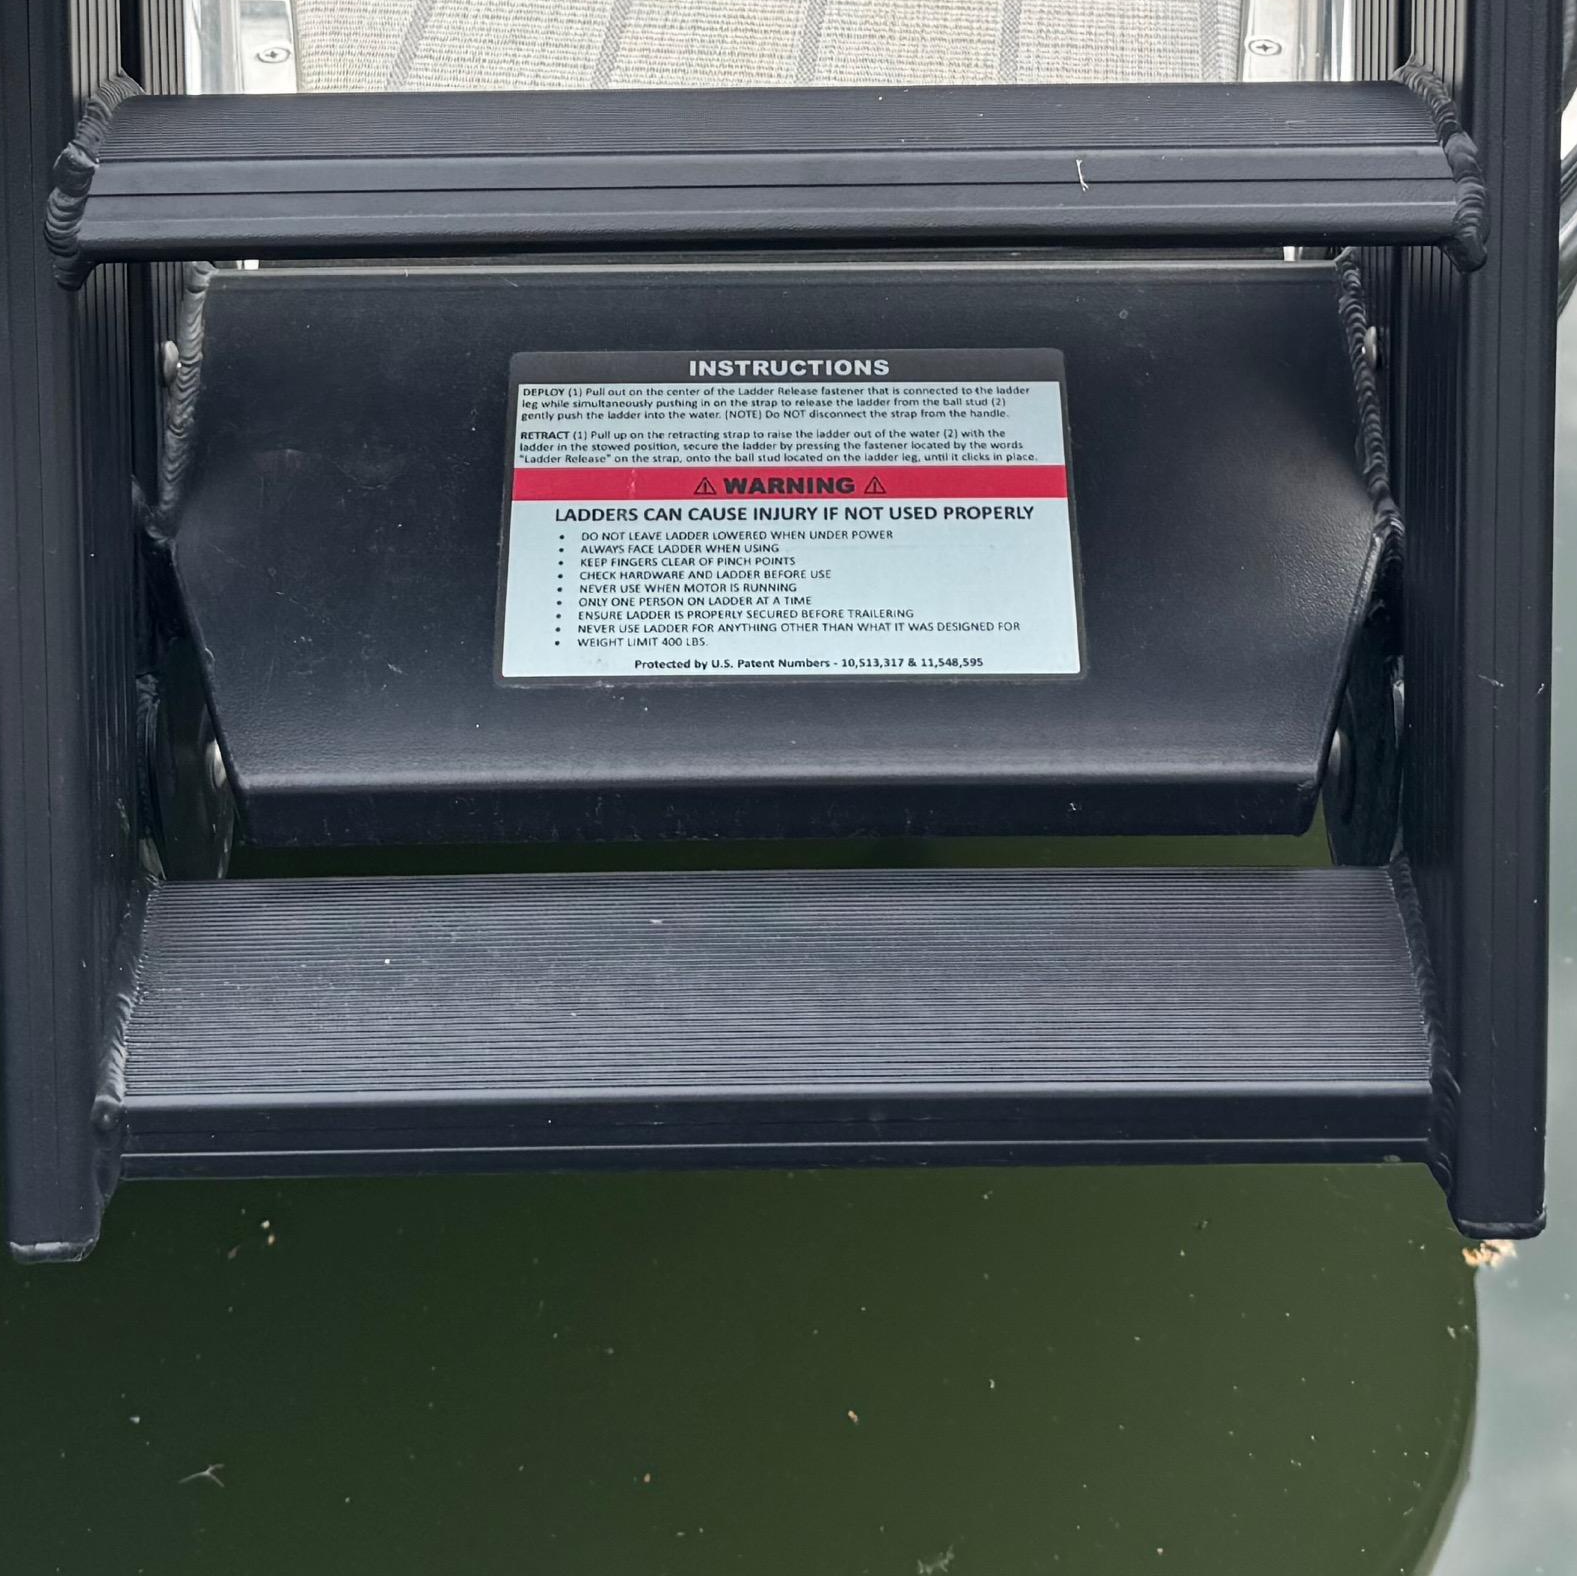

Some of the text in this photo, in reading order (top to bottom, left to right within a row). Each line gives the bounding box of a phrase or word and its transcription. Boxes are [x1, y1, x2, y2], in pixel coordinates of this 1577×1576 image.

[690, 359, 889, 377] INSTRUCTIONS
[523, 388, 565, 397] DEPLOY
[568, 387, 583, 398] (1)
[585, 387, 605, 396] Pull
[646, 387, 664, 396] the
[666, 388, 700, 396] center
[703, 387, 714, 396] of
[717, 387, 736, 396] the
[738, 387, 774, 396] Ladder
[777, 386, 818, 396] Release
[821, 386, 865, 396] fastener
[867, 386, 889, 396] that
[892, 387, 900, 395] is
[903, 386, 959, 395] connected
[961, 387, 973, 395] to
[974, 386, 993, 395] the
[996, 386, 1030, 395] ladder
[520, 428, 1006, 441] RETRACT (1) Pull up on the retracting strap to raise the ladder out of the water (2) with the
[723, 477, 855, 495] WARNING
[555, 506, 1034, 522] LADDERS CAN CAUSE INJURY IF NOT USED PROPERLY
[581, 530, 893, 541] DO NOT LEAVE LADDER LOWERED WHEN UNDER POWER
[580, 543, 780, 554] ALWAYS FACE LADDER WHEN USING
[580, 556, 796, 568] KEEP FINGERS CLEAR OF PINCH POINTS
[579, 569, 831, 581] CHECK HARDWARE AND LADDER BEFORE USE
[579, 582, 797, 594] NEVER USE WHEN MOTOR IS RUNNING
[578, 596, 811, 607] ONLY ONE PERSON ON LADDER AT A TIME
[578, 609, 914, 621] ENSURE LADDER IS PROPERLY SECURED BEFORE TRAILERING
[577, 621, 1021, 634] NEVER USE LADDER FOR ANYTHING OTHER THAN WHAT IT WAS DESIGNED FOR
[577, 636, 708, 648] WEIGHT LIMIT 400 LBS.
[634, 659, 691, 669] Protected
[694, 659, 708, 671] by
[711, 658, 734, 669] U.S.
[737, 659, 775, 668] Patent
[778, 658, 831, 668] Numbers
[842, 658, 904, 669] 10,513,317
[907, 657, 917, 667] &
[921, 657, 984, 669] 11,548,595
